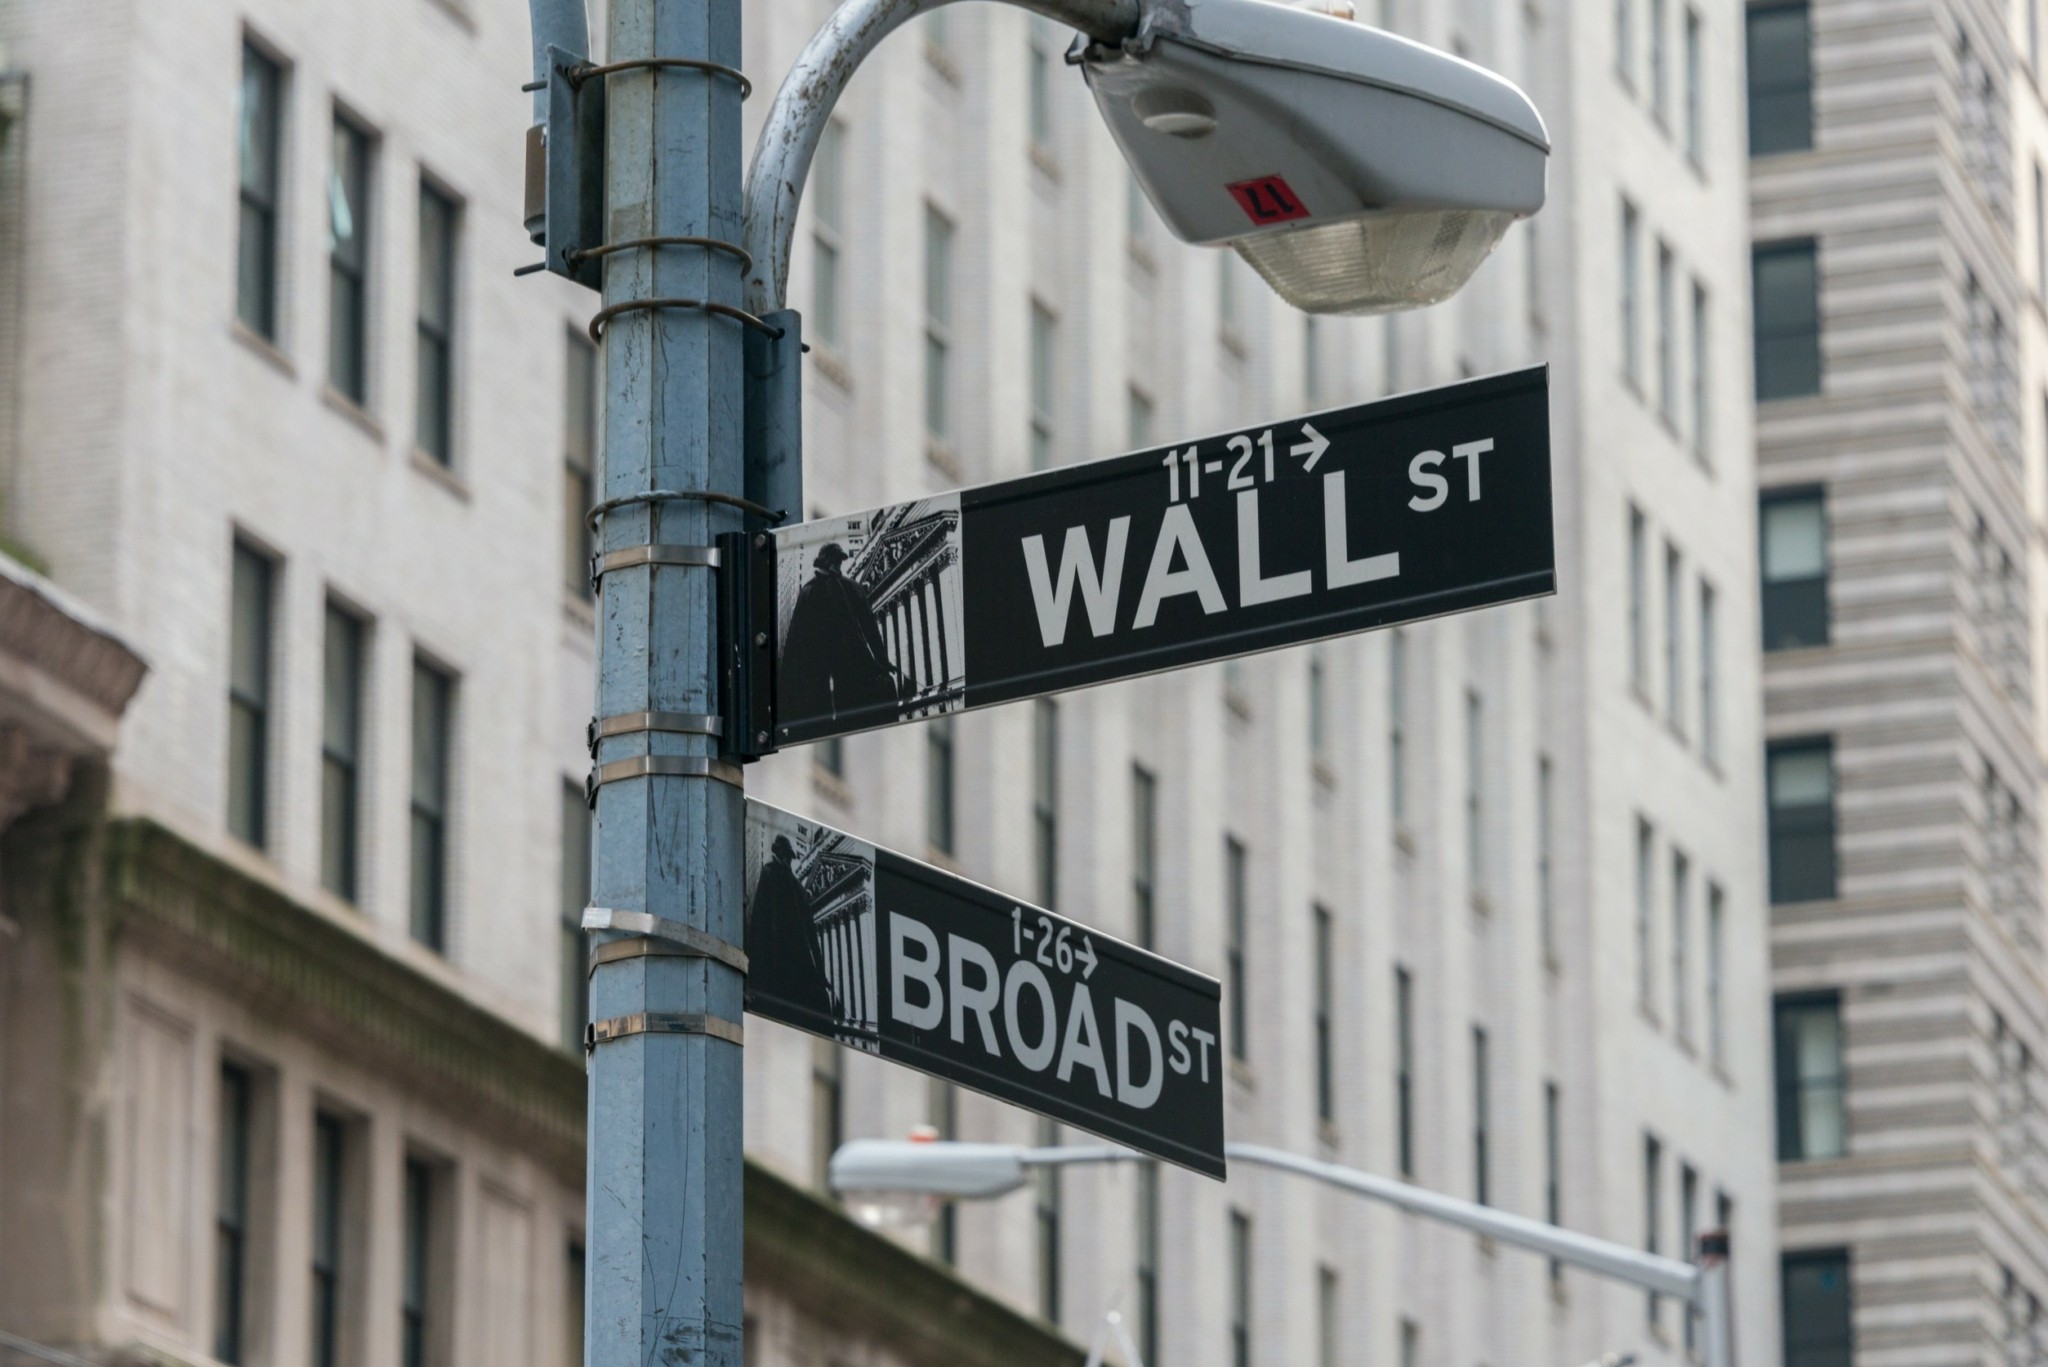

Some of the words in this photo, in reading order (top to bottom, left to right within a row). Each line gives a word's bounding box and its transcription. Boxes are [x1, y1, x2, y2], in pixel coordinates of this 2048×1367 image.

[1162, 429, 1275, 503] 11-21
[1021, 470, 1400, 648] WALL
[1408, 437, 1494, 512] ST
[1011, 906, 1073, 974] 1-26
[889, 911, 1164, 1109] BROAD
[1168, 1019, 1215, 1083] ST
